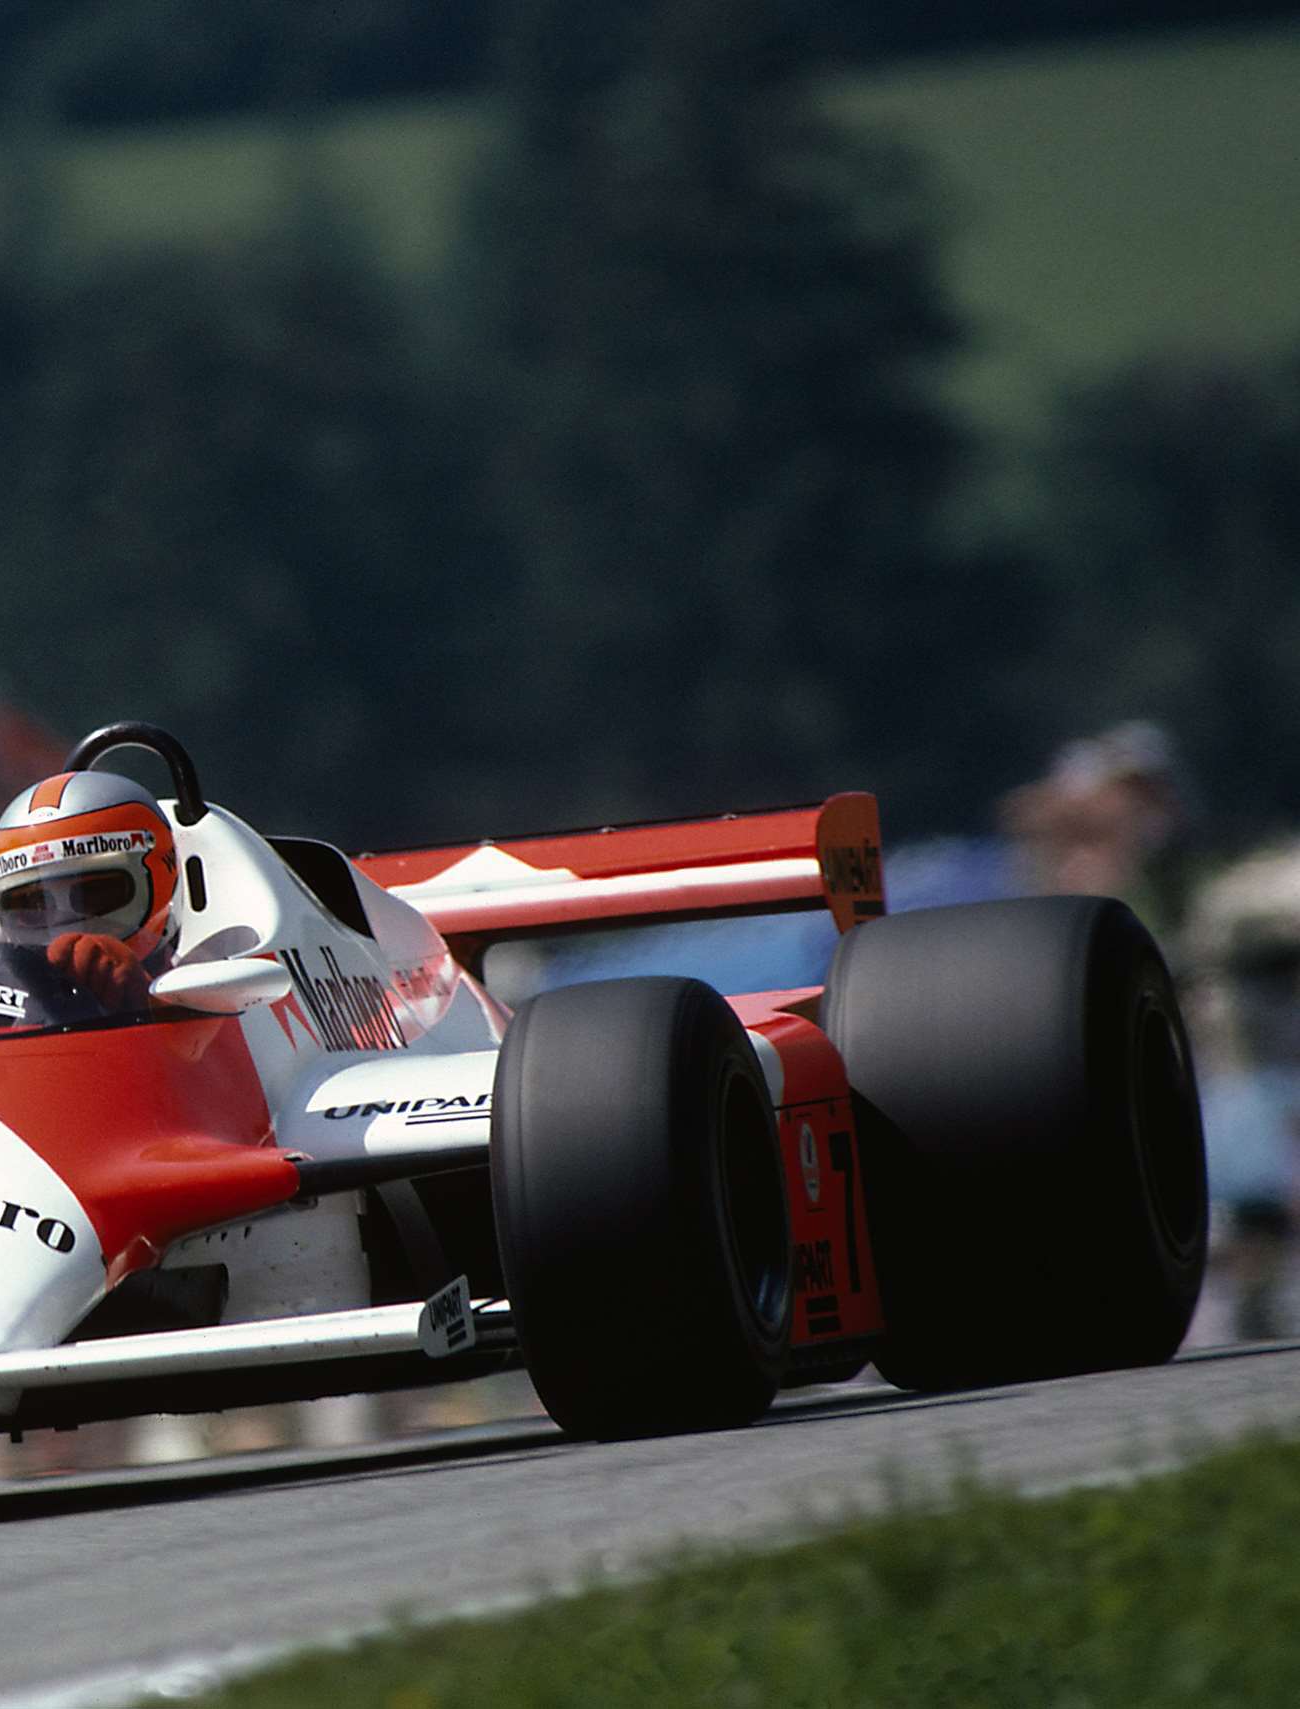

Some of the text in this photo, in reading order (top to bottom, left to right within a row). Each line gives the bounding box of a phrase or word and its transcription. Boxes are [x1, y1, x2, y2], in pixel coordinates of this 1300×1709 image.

[62, 836, 131, 857] Marlboro
[279, 946, 408, 1052] Marlboro
[828, 1130, 861, 1293] 7
